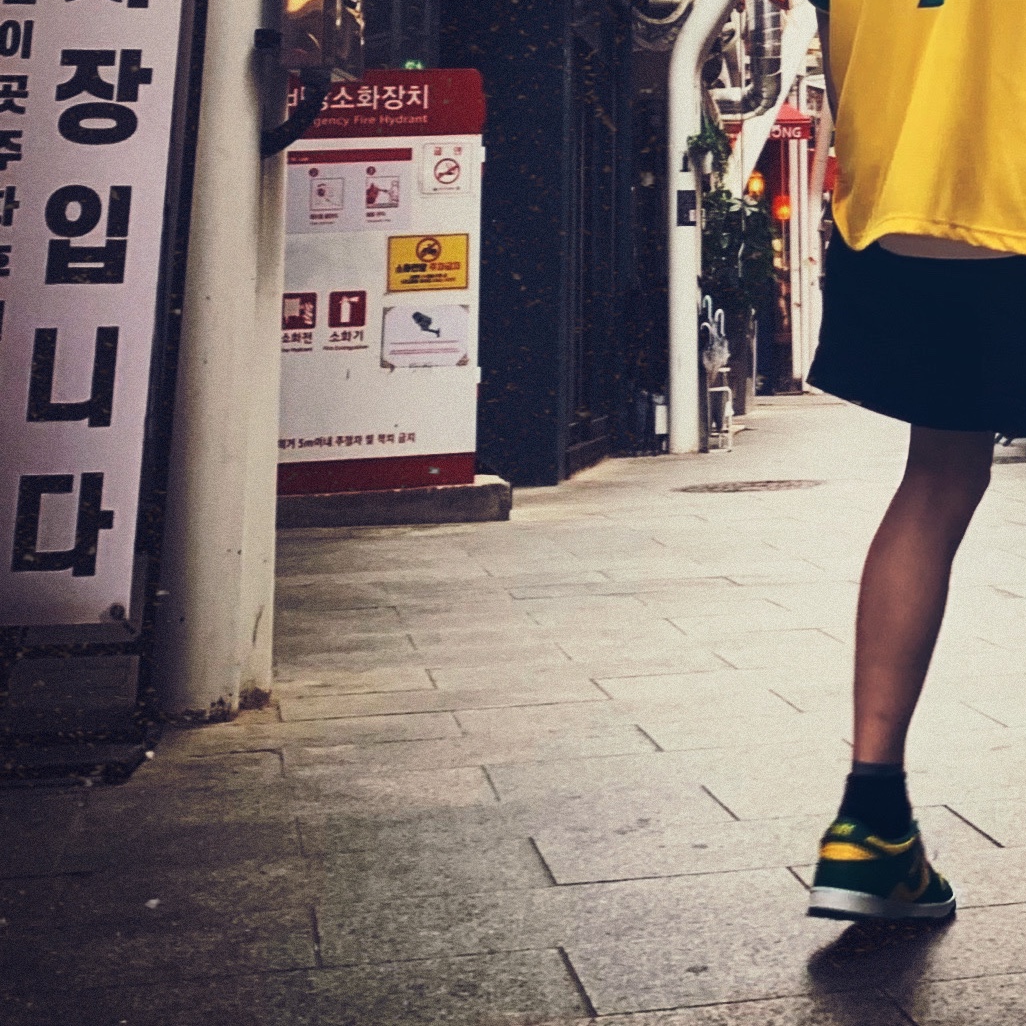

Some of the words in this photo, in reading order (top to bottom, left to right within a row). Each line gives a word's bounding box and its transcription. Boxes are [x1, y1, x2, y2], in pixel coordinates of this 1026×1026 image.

[287, 84, 430, 111] 비소화장치
[354, 115, 376, 125] Fire
[379, 114, 429, 127] Hydrant
[329, 330, 364, 343] 소화기
[398, 432, 416, 444] 금지
